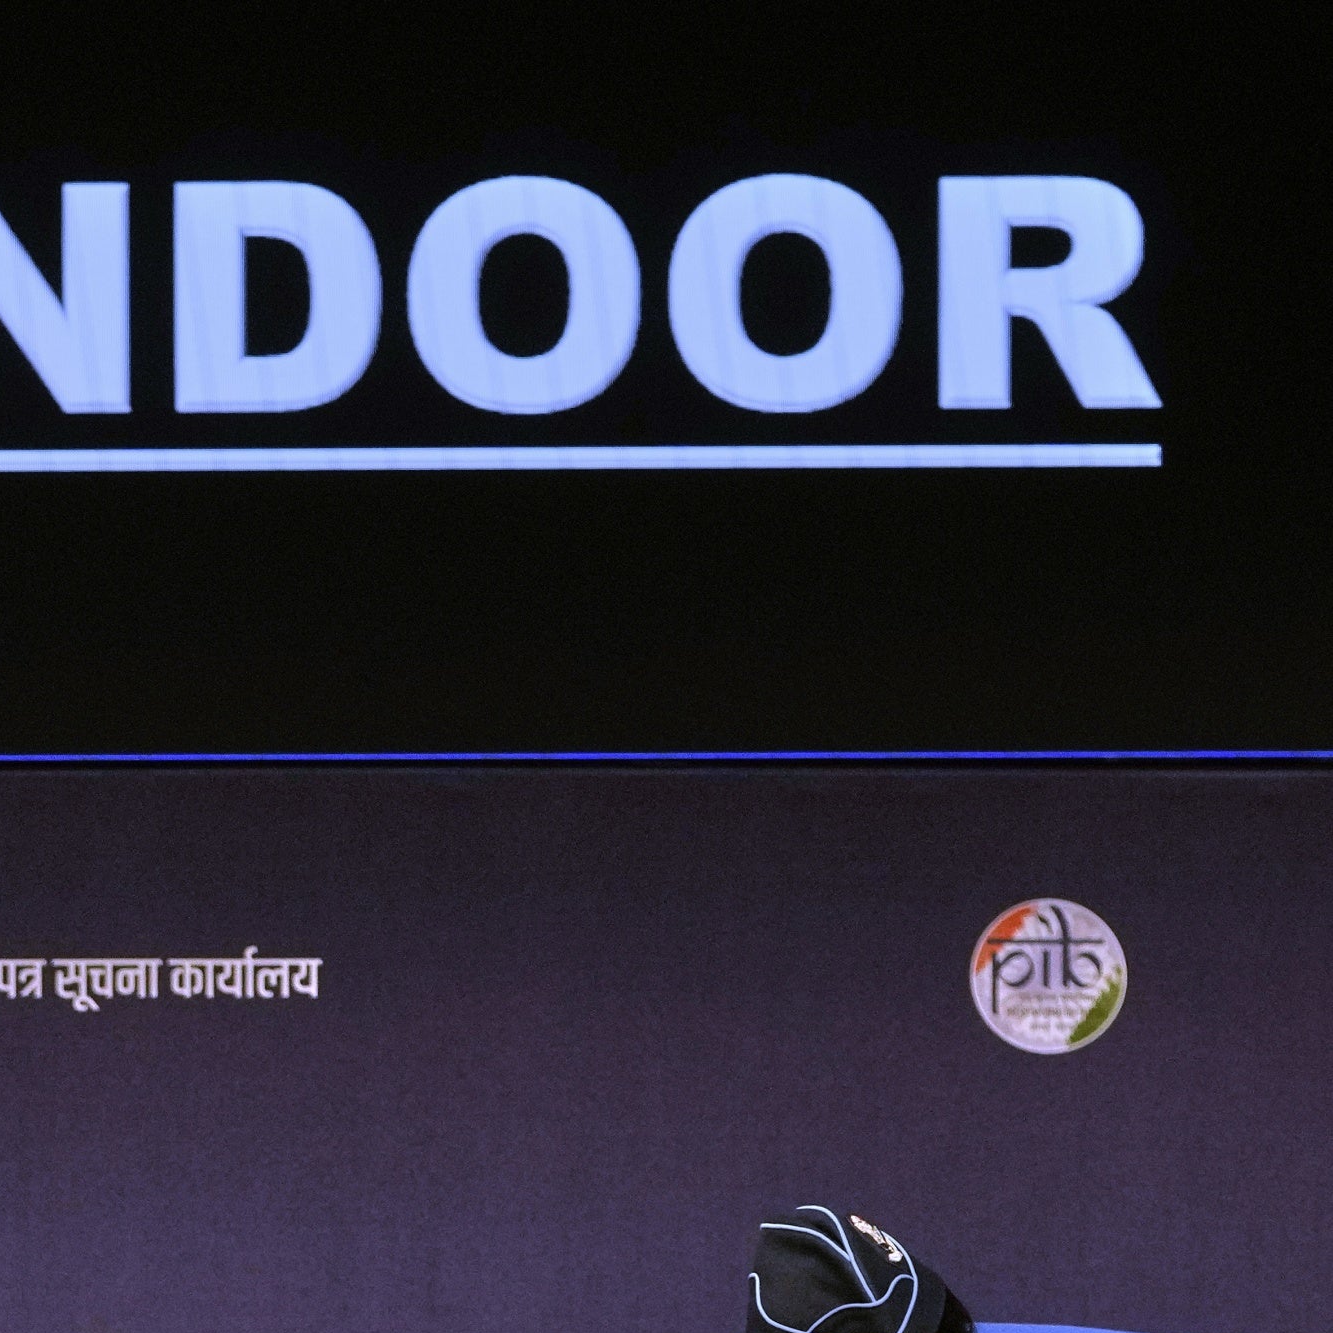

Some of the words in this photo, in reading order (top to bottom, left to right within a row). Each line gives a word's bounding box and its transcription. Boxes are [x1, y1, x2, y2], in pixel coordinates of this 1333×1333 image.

[51, 957, 164, 1013] सूचना
[167, 945, 324, 1000] कार्यालय
[987, 904, 1104, 1014] pib
